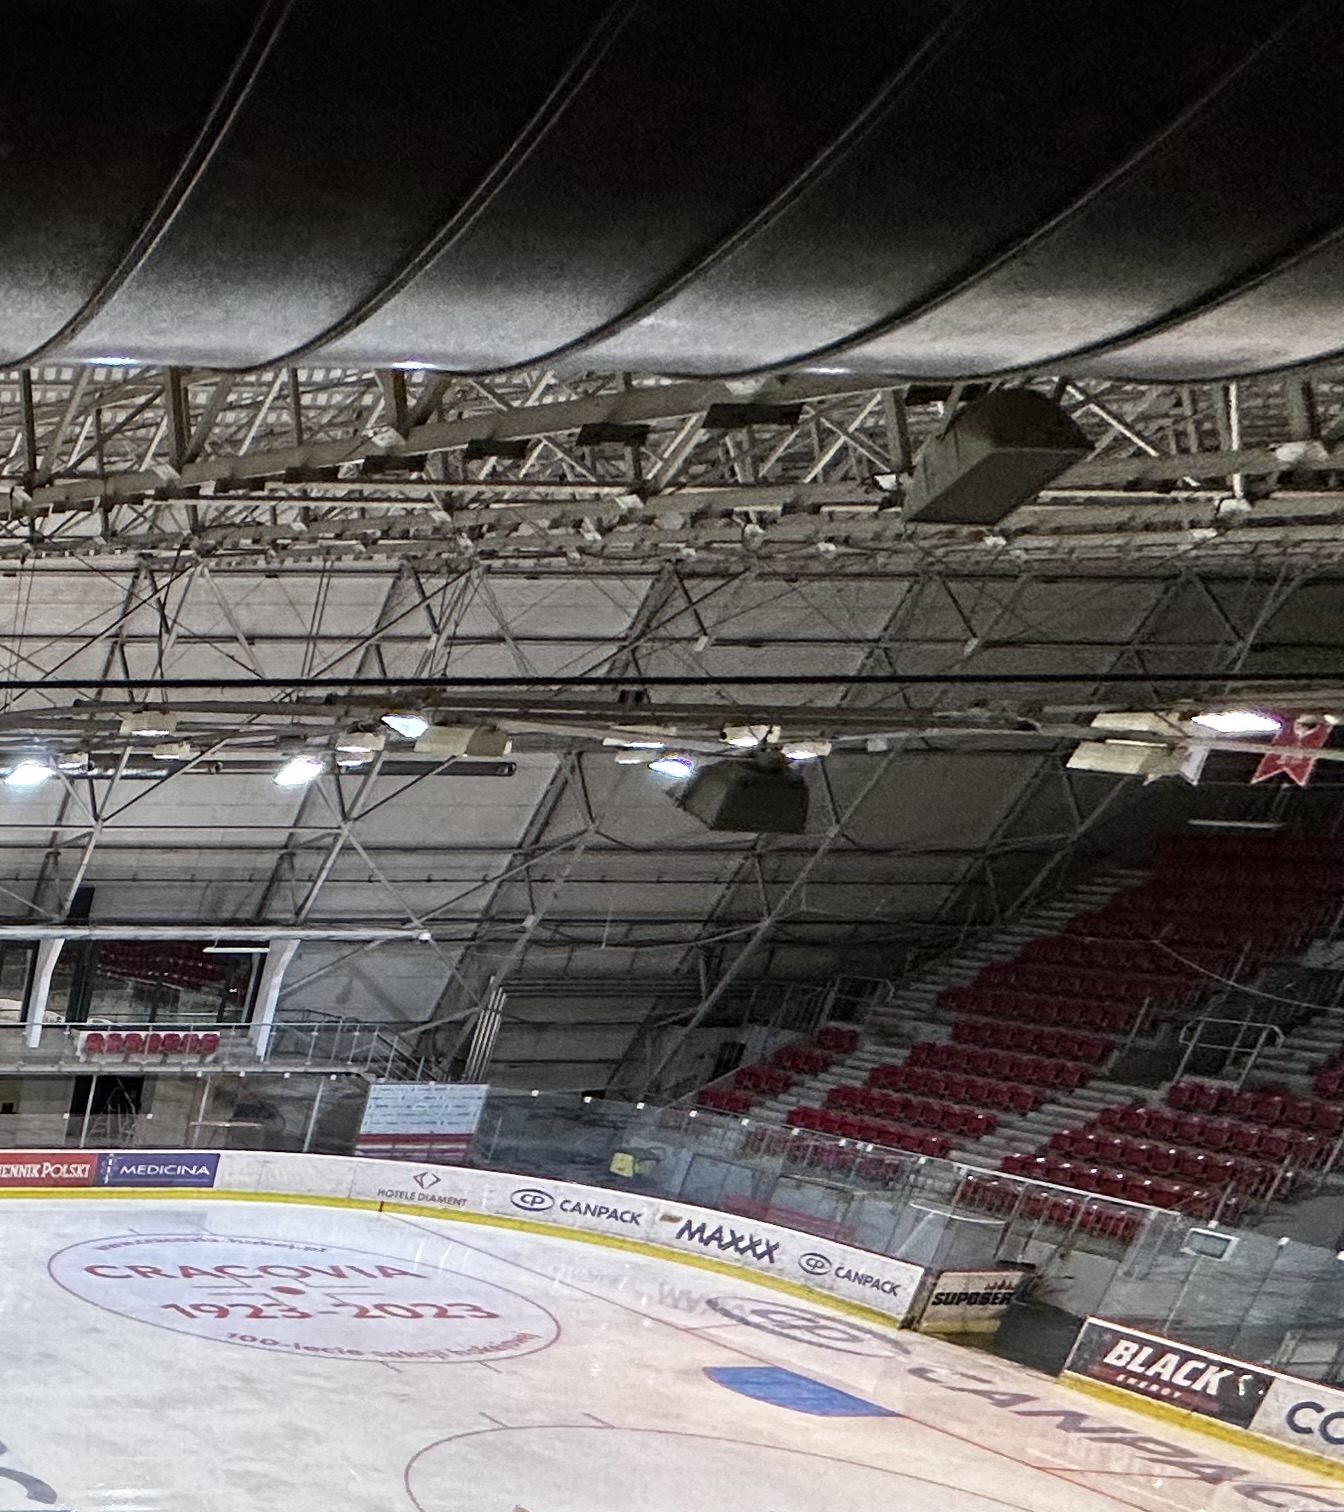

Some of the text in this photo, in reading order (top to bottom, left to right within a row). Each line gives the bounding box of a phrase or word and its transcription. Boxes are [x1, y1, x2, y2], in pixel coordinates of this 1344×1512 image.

[41, 1161, 91, 1178] POLSKI
[119, 1164, 210, 1176] MEDICINA
[377, 1188, 468, 1207] HOTELE DIAMENT
[559, 1199, 643, 1226] CANPACK
[676, 1219, 780, 1264] MAXXX
[83, 1264, 428, 1280] CRACOVIA
[833, 1265, 902, 1297] CANPACK
[160, 1303, 500, 1320] 1923-2023
[1103, 1339, 1234, 1397] BLACK
[1116, 1374, 1182, 1399] ENERGY
